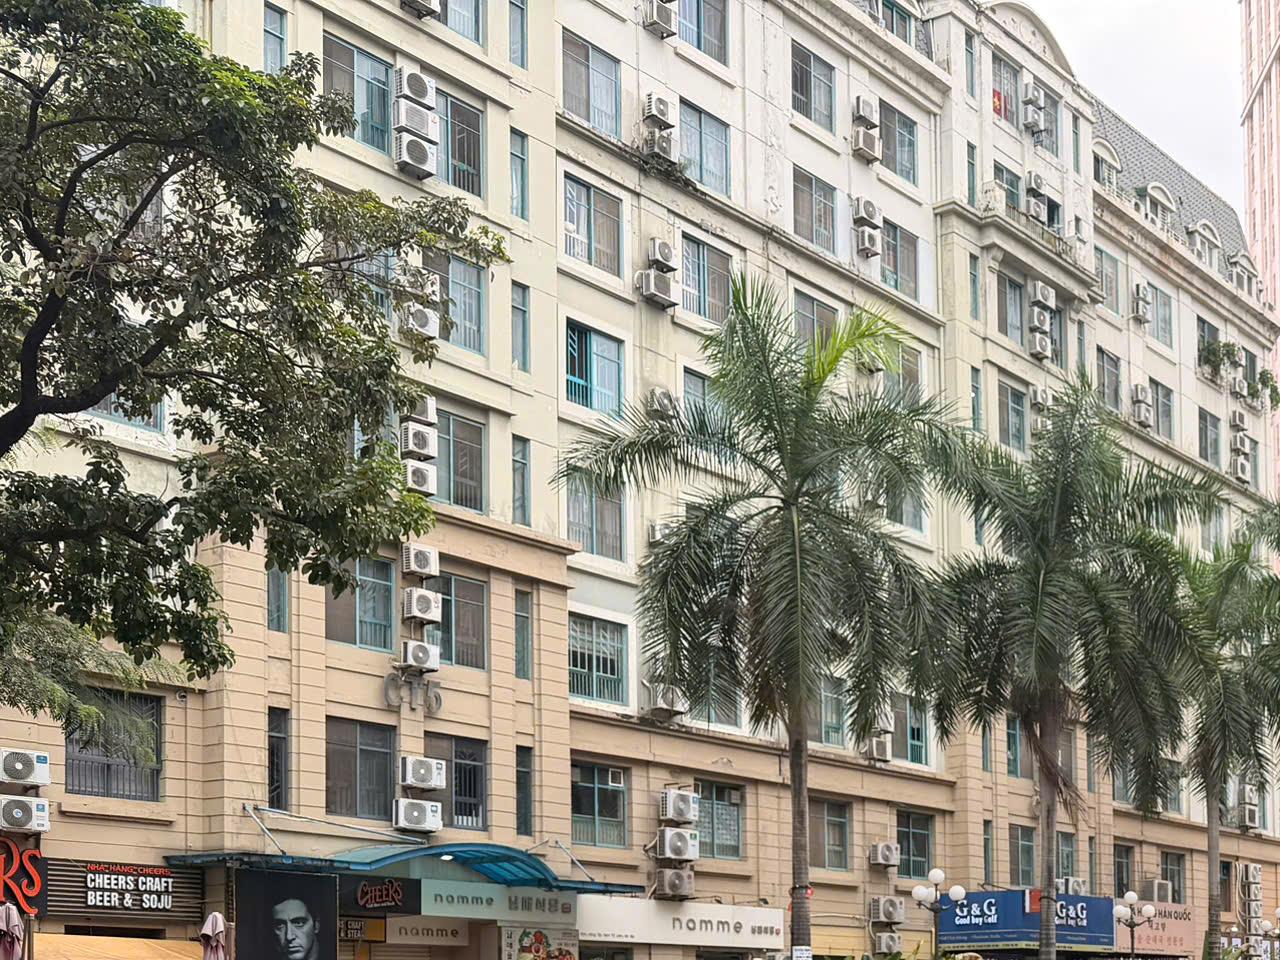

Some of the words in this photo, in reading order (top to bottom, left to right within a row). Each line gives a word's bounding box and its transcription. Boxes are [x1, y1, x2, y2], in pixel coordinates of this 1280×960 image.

[138, 867, 172, 877] CHEERS
[87, 873, 135, 890] CHEERS
[138, 876, 174, 892] CRAFT
[87, 891, 119, 907] BEER
[123, 893, 133, 907] &
[142, 894, 172, 909] SOJU
[358, 879, 402, 906] CHEERS
[955, 899, 968, 917] G
[971, 903, 981, 916] &
[983, 898, 996, 916] G
[1056, 900, 1067, 917] G
[1068, 904, 1077, 918] &
[1077, 902, 1087, 918] G
[954, 915, 970, 925] Good
[971, 915, 983, 926] buy
[984, 914, 998, 924] Golf
